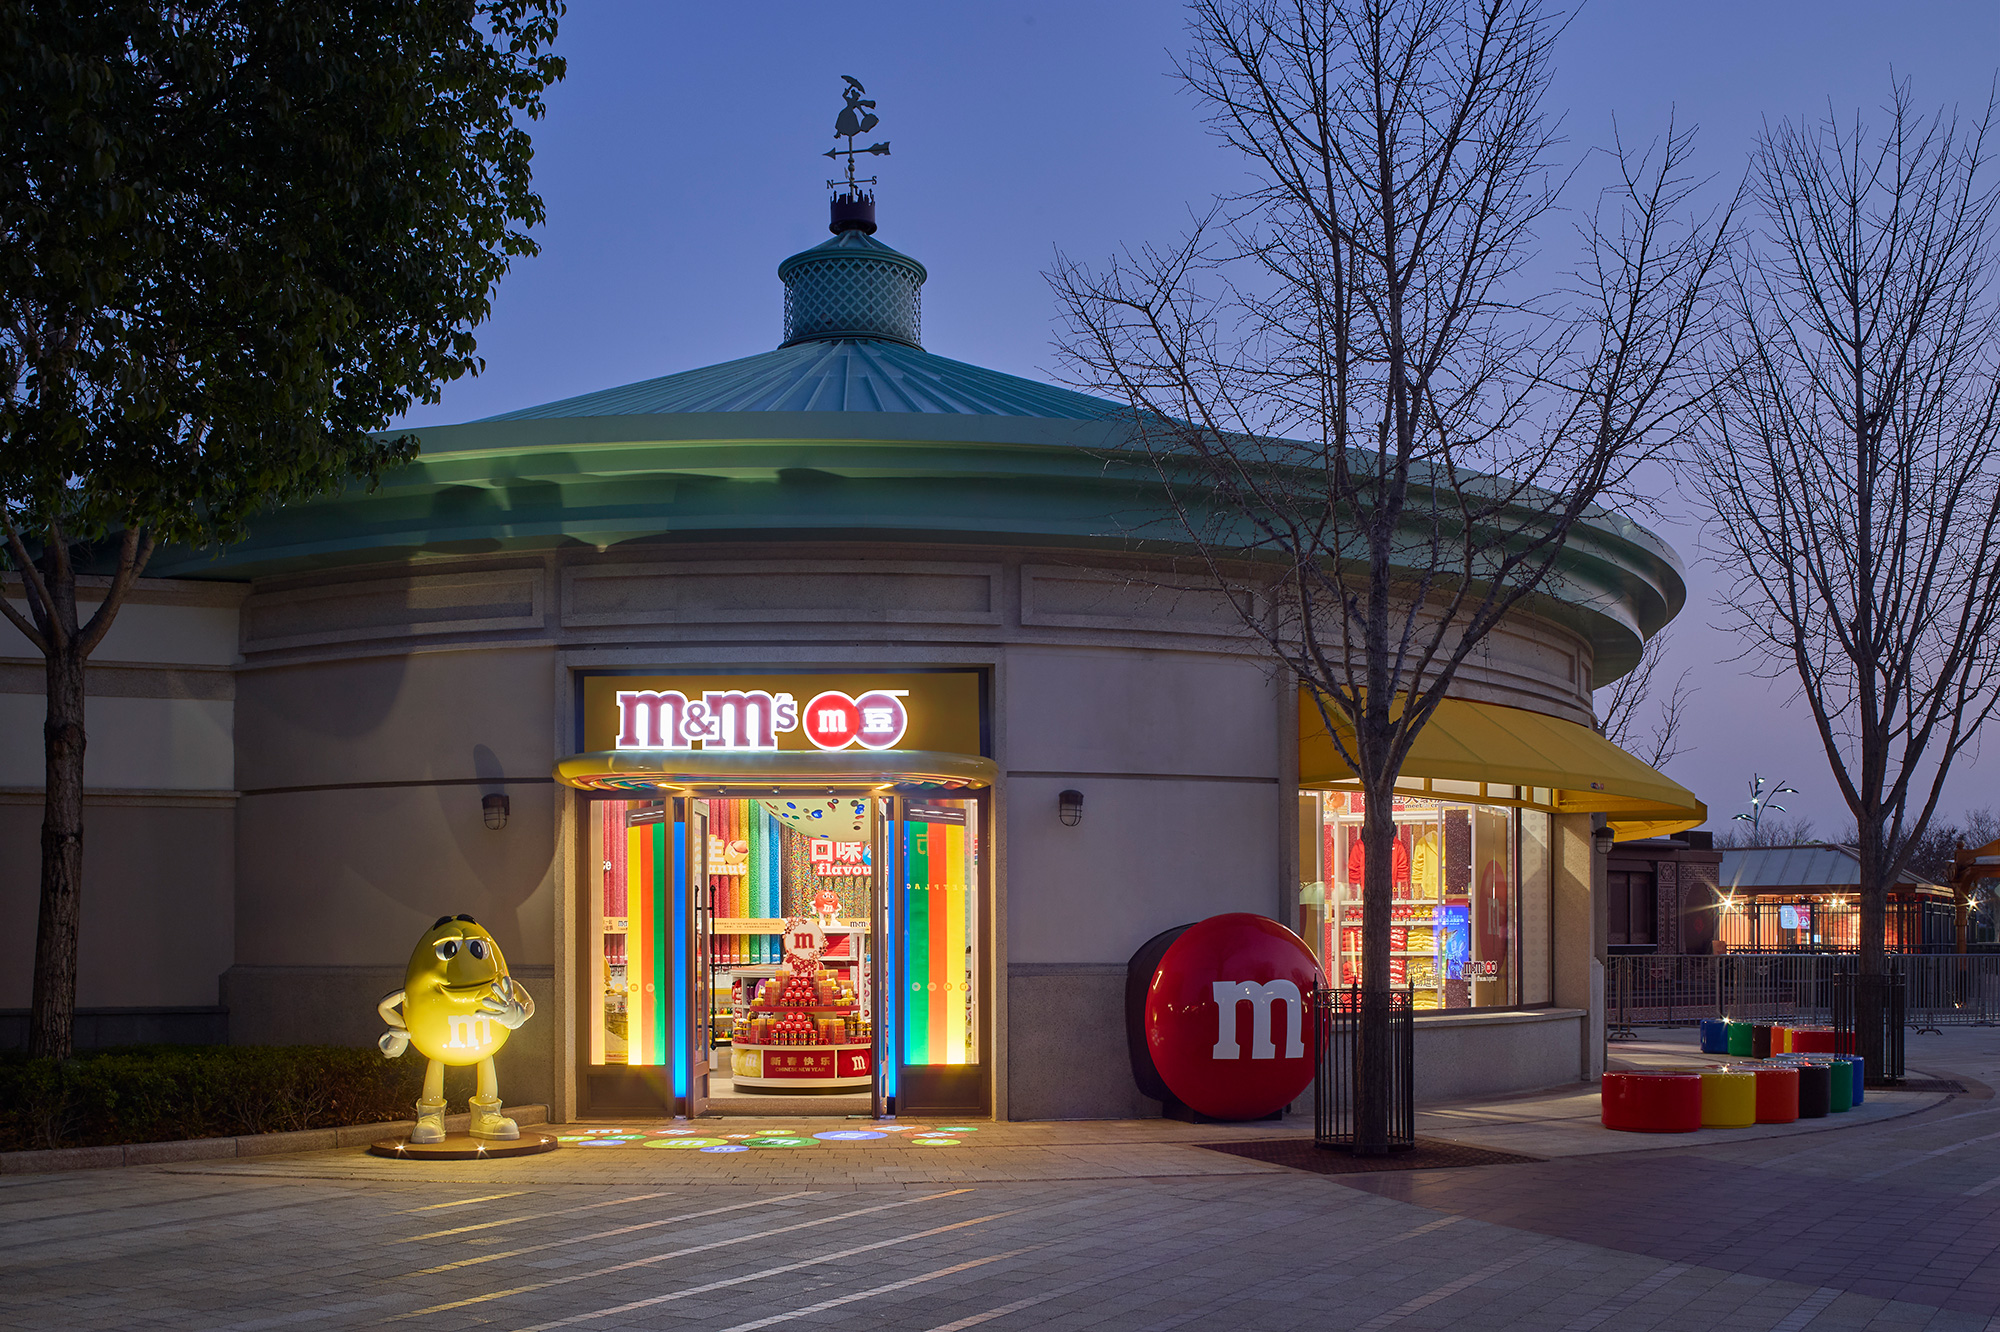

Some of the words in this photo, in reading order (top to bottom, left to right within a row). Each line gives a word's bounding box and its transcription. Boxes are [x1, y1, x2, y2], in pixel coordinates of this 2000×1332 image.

[826, 179, 835, 189] N
[871, 175, 878, 185] S
[813, 839, 862, 862] 口味
[817, 862, 872, 876] flavou
[794, 933, 815, 949] m
[1212, 979, 1305, 1060] m
[448, 1014, 492, 1048] m
[852, 1055, 866, 1071] m
